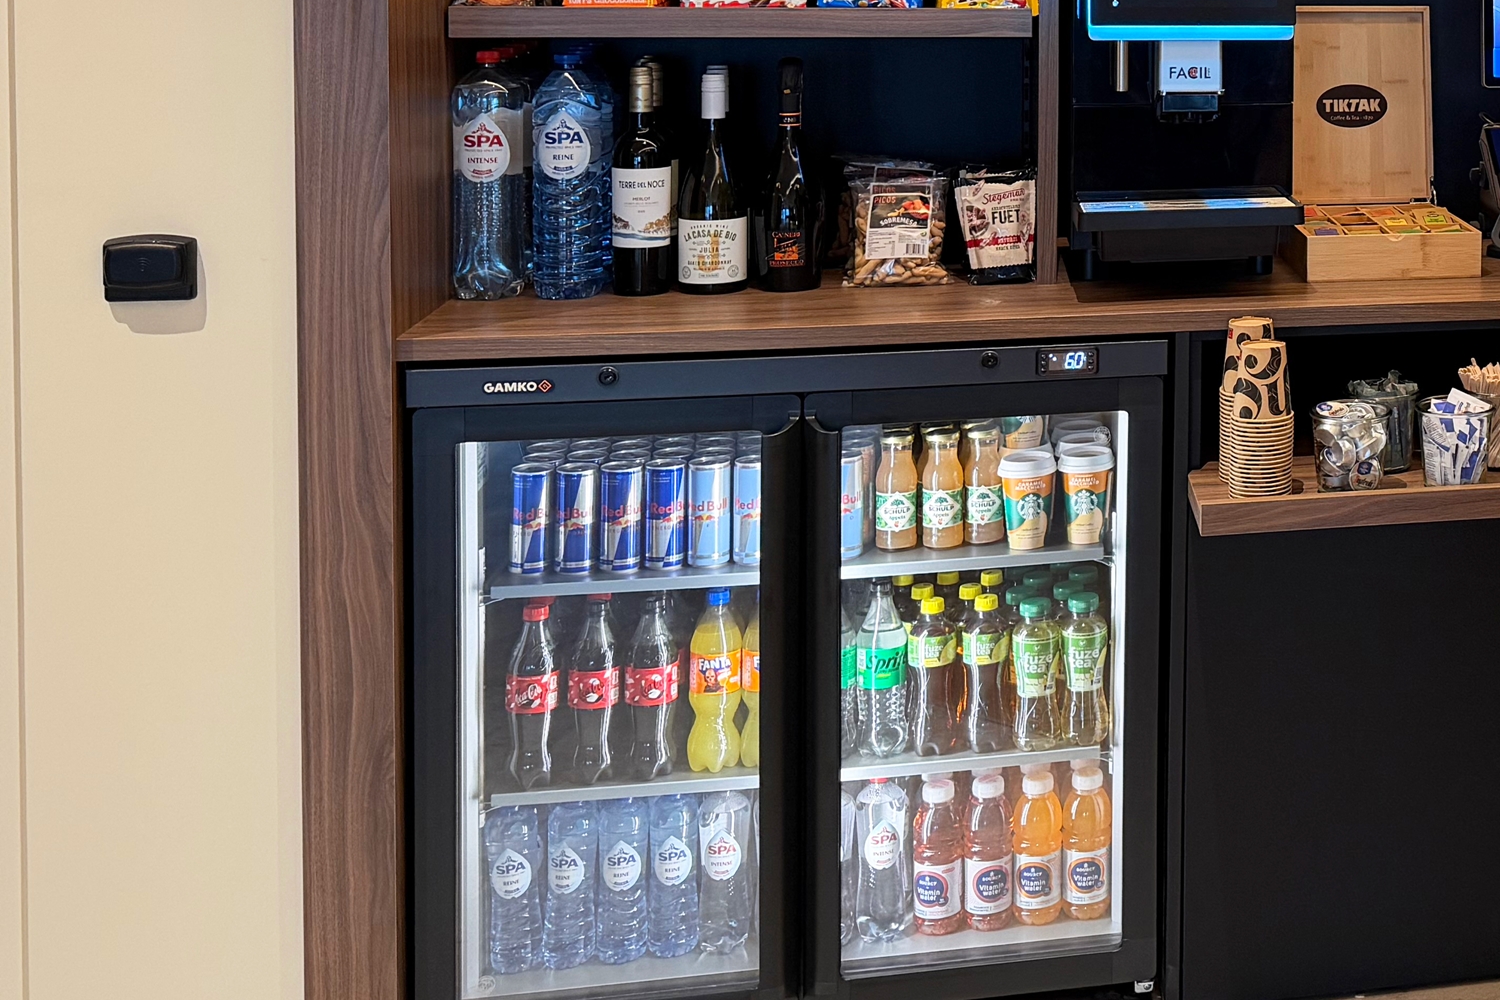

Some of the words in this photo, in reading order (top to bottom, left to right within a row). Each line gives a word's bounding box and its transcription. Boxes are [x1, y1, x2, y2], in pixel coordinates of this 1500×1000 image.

[1169, 66, 1211, 79] FACIL
[1323, 98, 1381, 113] TIKTAK
[464, 134, 503, 148] SPA
[544, 131, 584, 144] SPA
[619, 181, 637, 189] TERRE
[647, 179, 665, 189] NOCE
[874, 196, 896, 204] PICOS
[879, 216, 918, 227] SOBREMESA
[991, 209, 1020, 225] FUET
[684, 233, 692, 242] LA
[692, 229, 711, 238] CASA
[714, 230, 723, 238] DE
[724, 231, 737, 241] BIO
[483, 382, 537, 393] GAMKO
[650, 503, 674, 514] Red
[924, 644, 944, 653] fuze
[976, 641, 995, 651] fuze
[924, 650, 940, 659] tea
[976, 648, 991, 657] tea
[1024, 652, 1052, 664] fuze
[1069, 648, 1099, 660] fuze
[1025, 663, 1045, 674] tea
[1069, 658, 1091, 669] tea
[870, 834, 897, 845] SPA
[708, 843, 737, 855] SPA
[607, 854, 637, 867] SPA
[658, 850, 686, 862] SPA
[496, 861, 526, 875] SPA
[550, 857, 579, 869] SPA
[1020, 879, 1045, 887] Vitamin
[1073, 873, 1099, 882] Vitamin
[917, 887, 940, 897] Vitamin
[979, 883, 1005, 892] Vitamin
[1024, 884, 1042, 892] water
[920, 893, 937, 901] water
